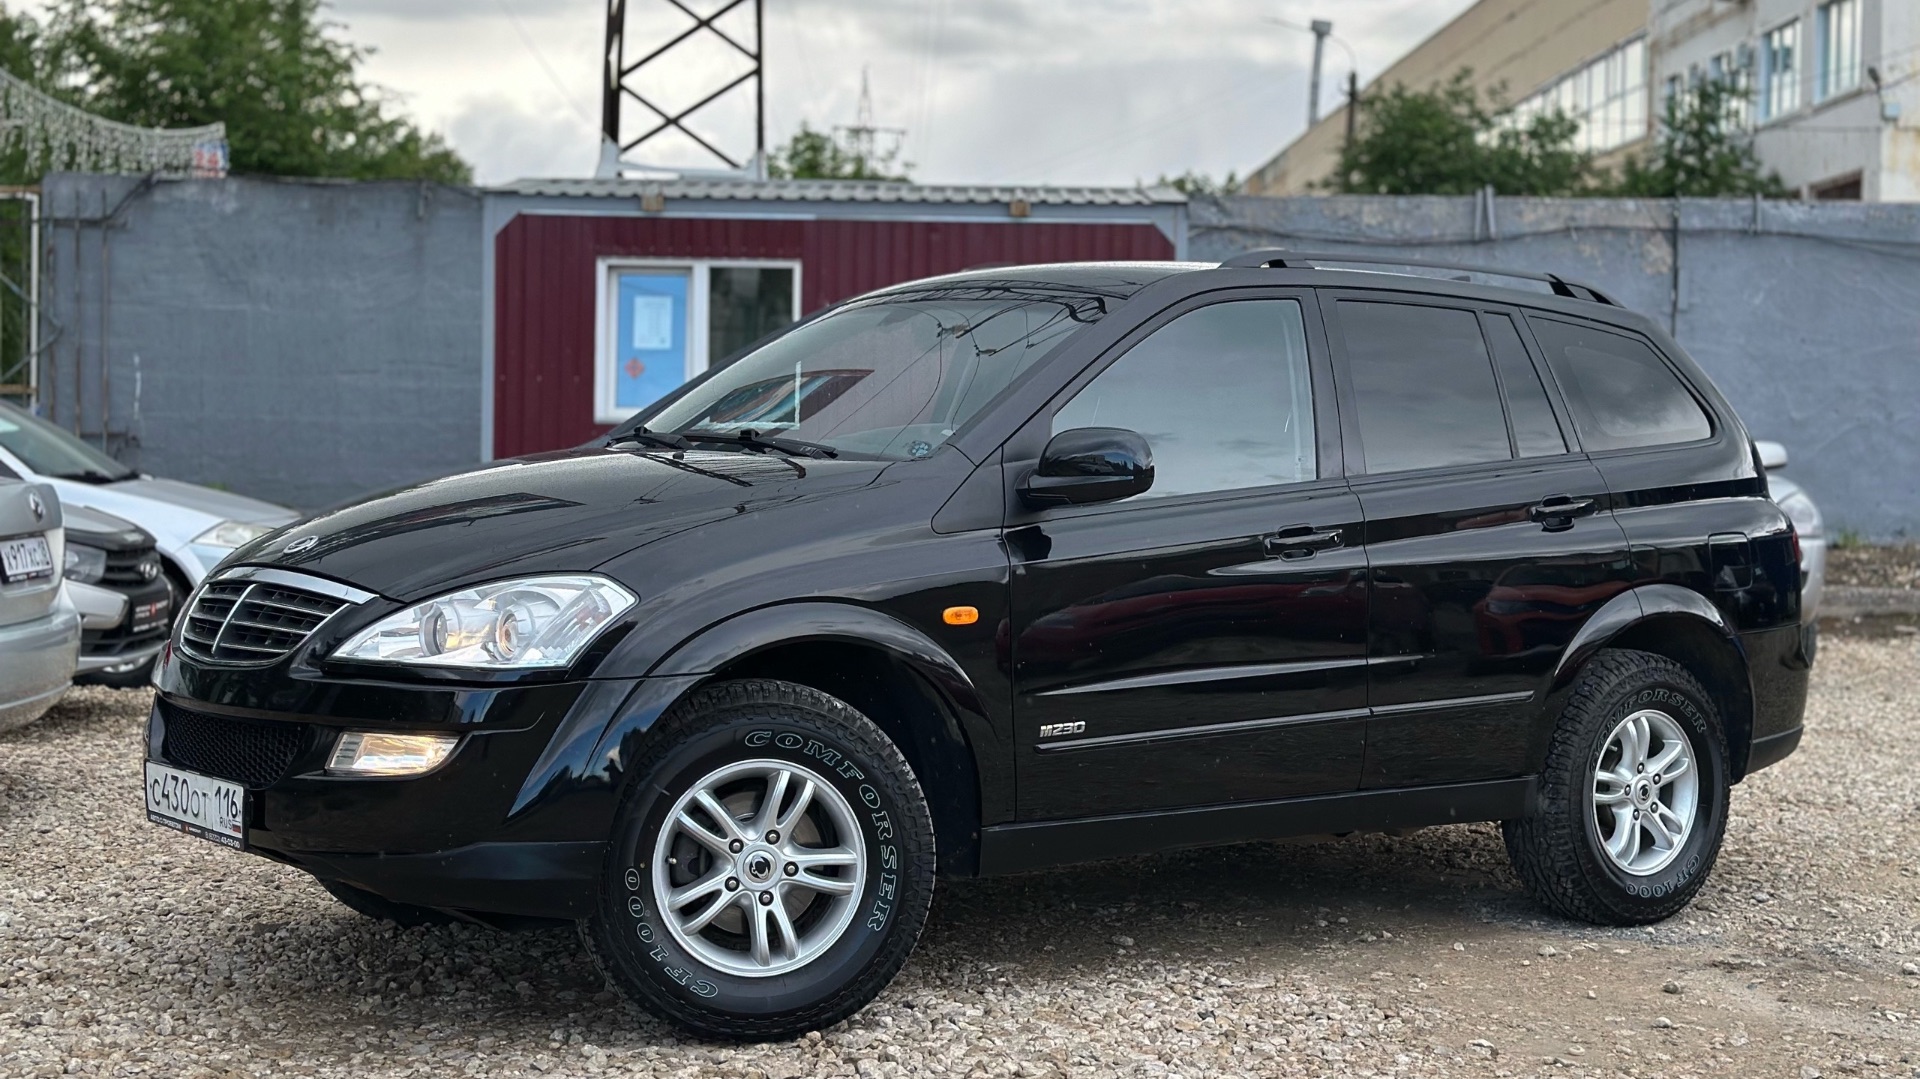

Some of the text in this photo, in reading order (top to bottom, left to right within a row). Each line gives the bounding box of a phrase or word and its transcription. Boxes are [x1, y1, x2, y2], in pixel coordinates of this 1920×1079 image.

[1040, 721, 1086, 738] M230
[152, 773, 238, 821] С430ОТ 116
[219, 816, 233, 830] RUS
[745, 730, 898, 932] COMFORSER
[1625, 854, 1700, 898] CF1000
[625, 868, 719, 999] CF1000
